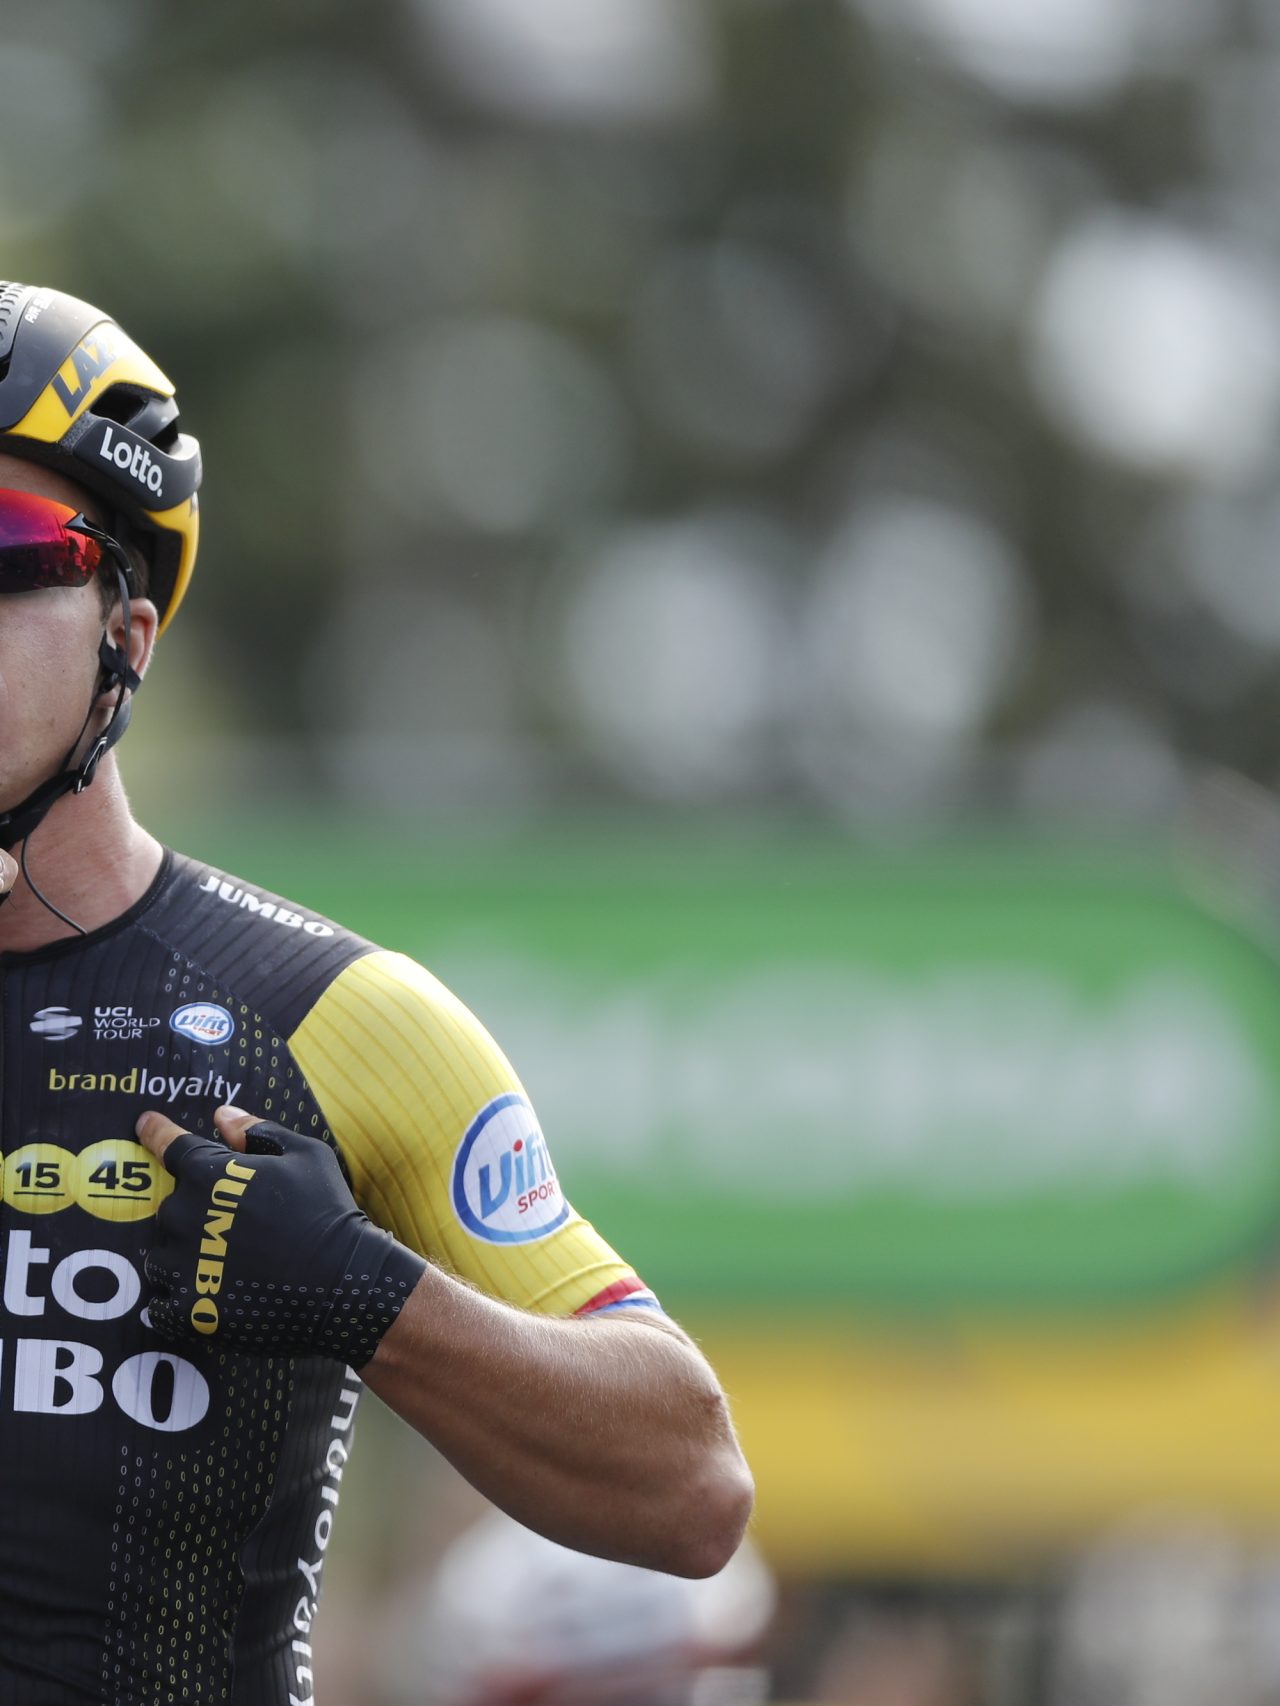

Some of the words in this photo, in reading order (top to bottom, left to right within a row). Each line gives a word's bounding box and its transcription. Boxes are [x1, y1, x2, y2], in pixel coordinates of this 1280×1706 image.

[199, 875, 335, 937] JUMBO
[94, 1006, 133, 1017] UCI
[94, 1017, 161, 1028] WORLD
[94, 1028, 143, 1040] TOUR
[49, 1068, 242, 1106] brandloyalty
[16, 1162, 60, 1189] 15
[88, 1160, 152, 1191] 45
[517, 1181, 556, 1214] SPOR
[191, 1158, 257, 1335] JUMBO
